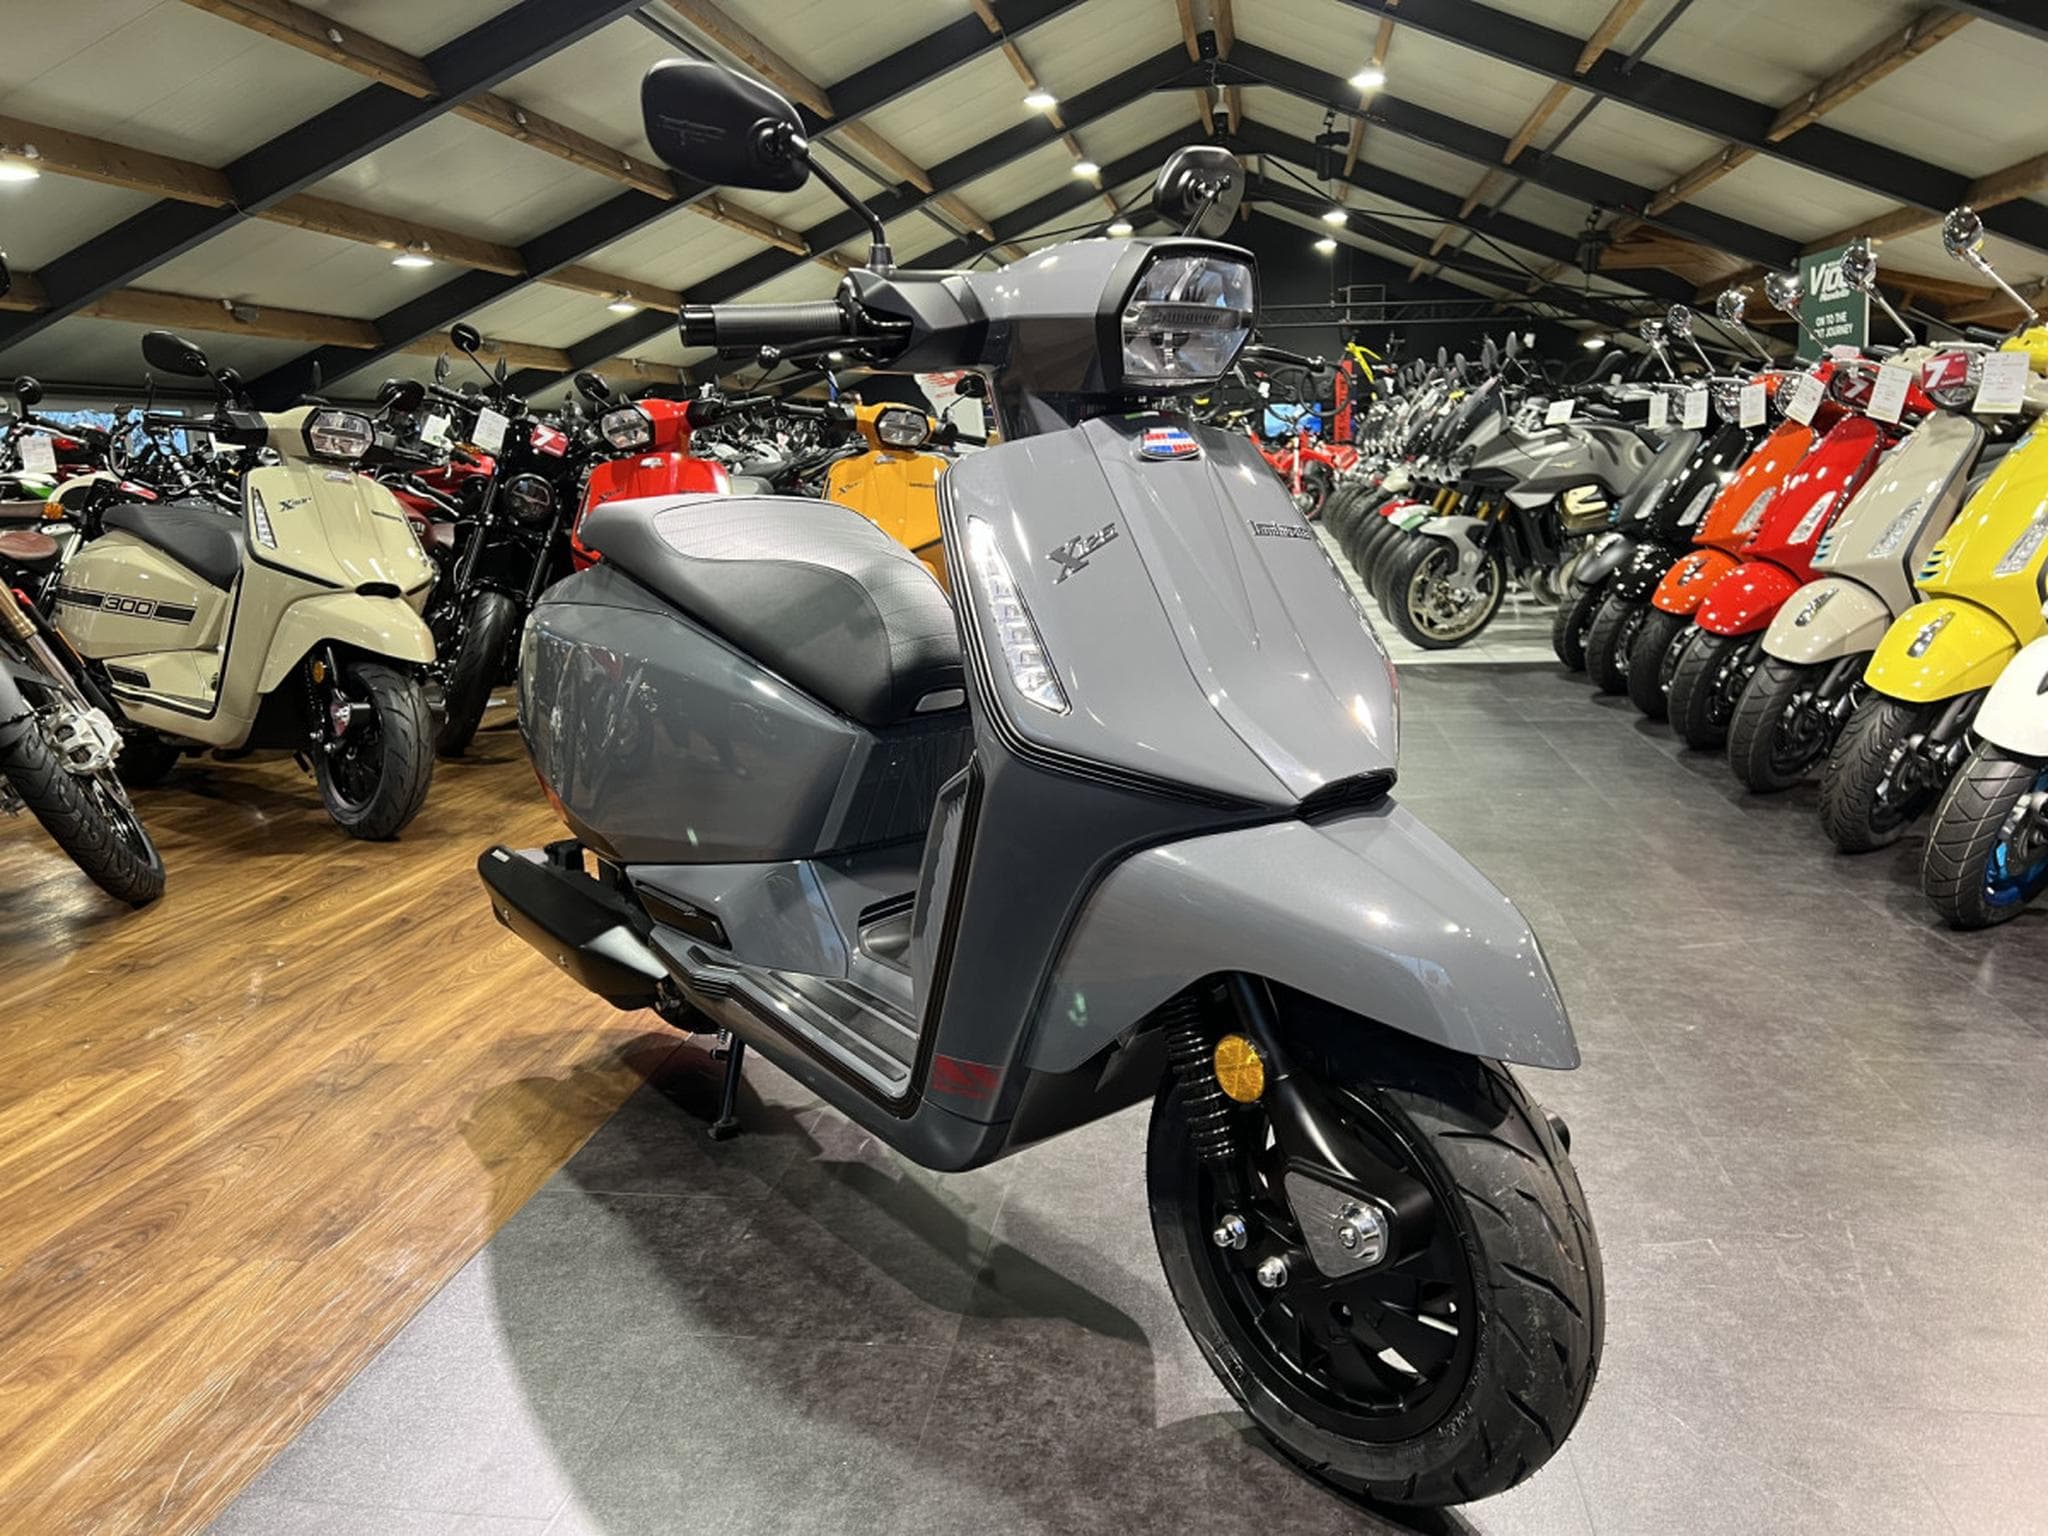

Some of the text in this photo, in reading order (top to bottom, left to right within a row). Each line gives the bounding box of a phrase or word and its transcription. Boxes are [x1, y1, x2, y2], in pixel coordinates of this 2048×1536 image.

[1815, 311, 1848, 327] ON TO THE
[1826, 323, 1853, 338] JOURNEY
[1925, 358, 1950, 388] 7
[1845, 379, 1869, 398] 7
[533, 426, 556, 447] 7
[104, 596, 153, 615] 300
